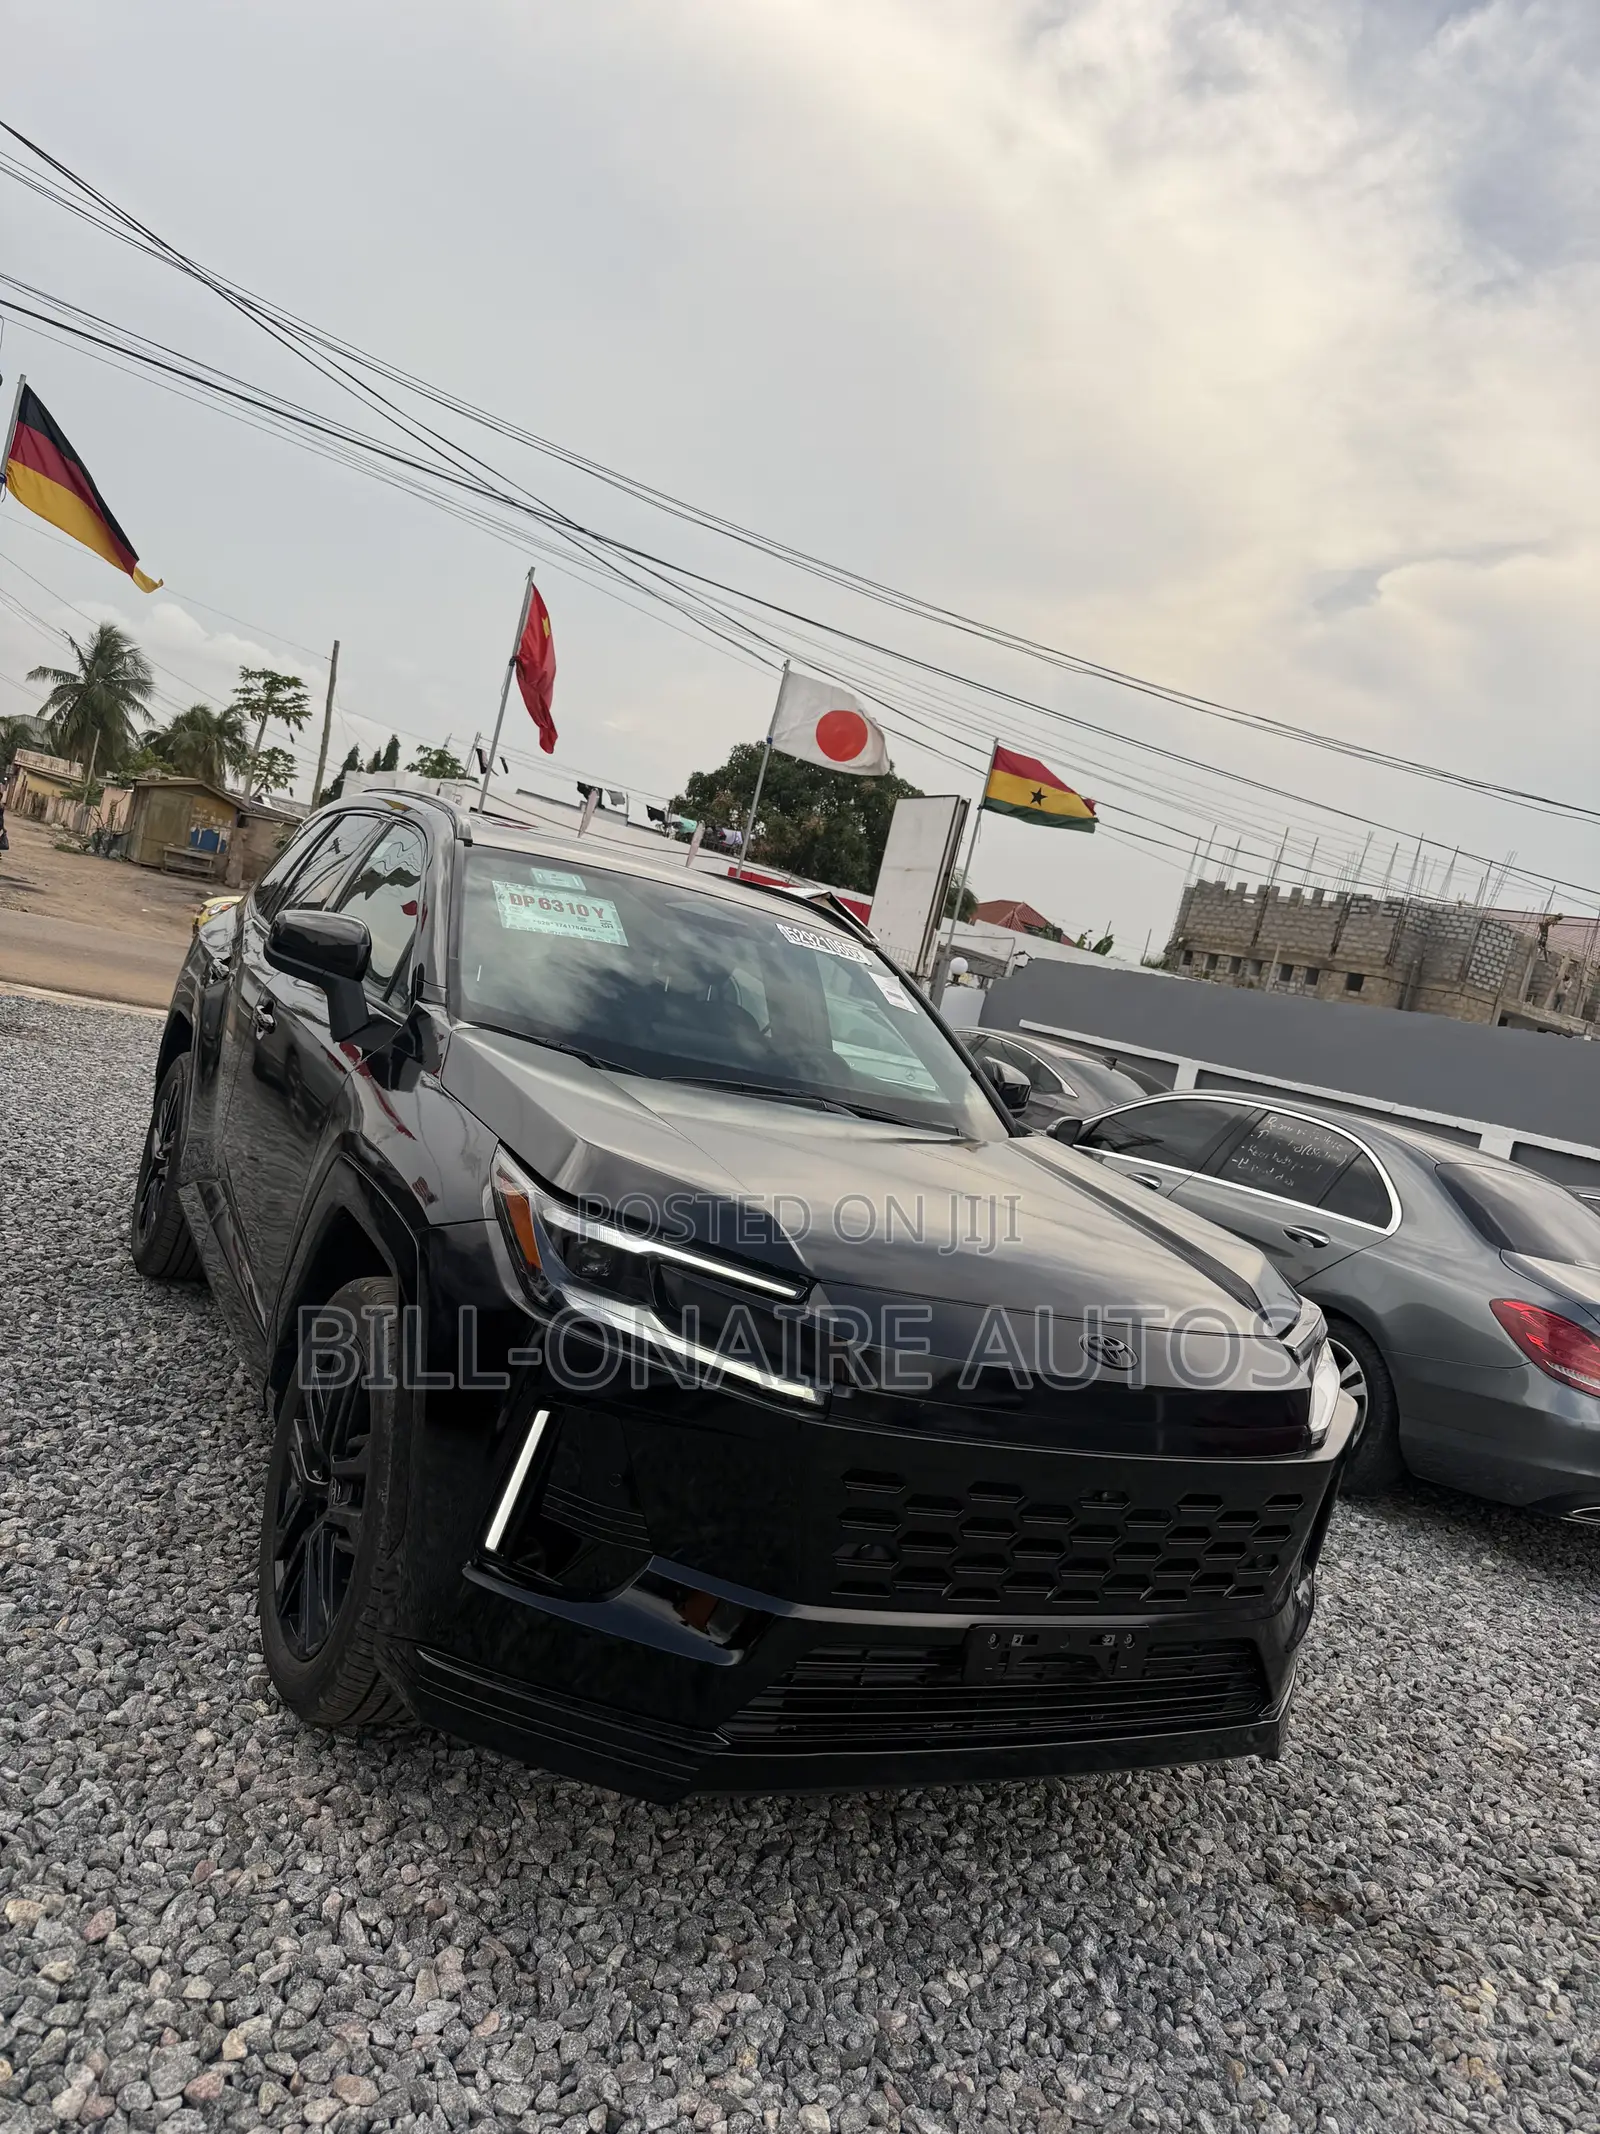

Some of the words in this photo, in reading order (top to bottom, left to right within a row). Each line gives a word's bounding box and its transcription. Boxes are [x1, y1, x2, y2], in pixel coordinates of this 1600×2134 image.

[508, 892, 536, 908] DP
[538, 897, 590, 917] 6310
[591, 905, 605, 919] Y
